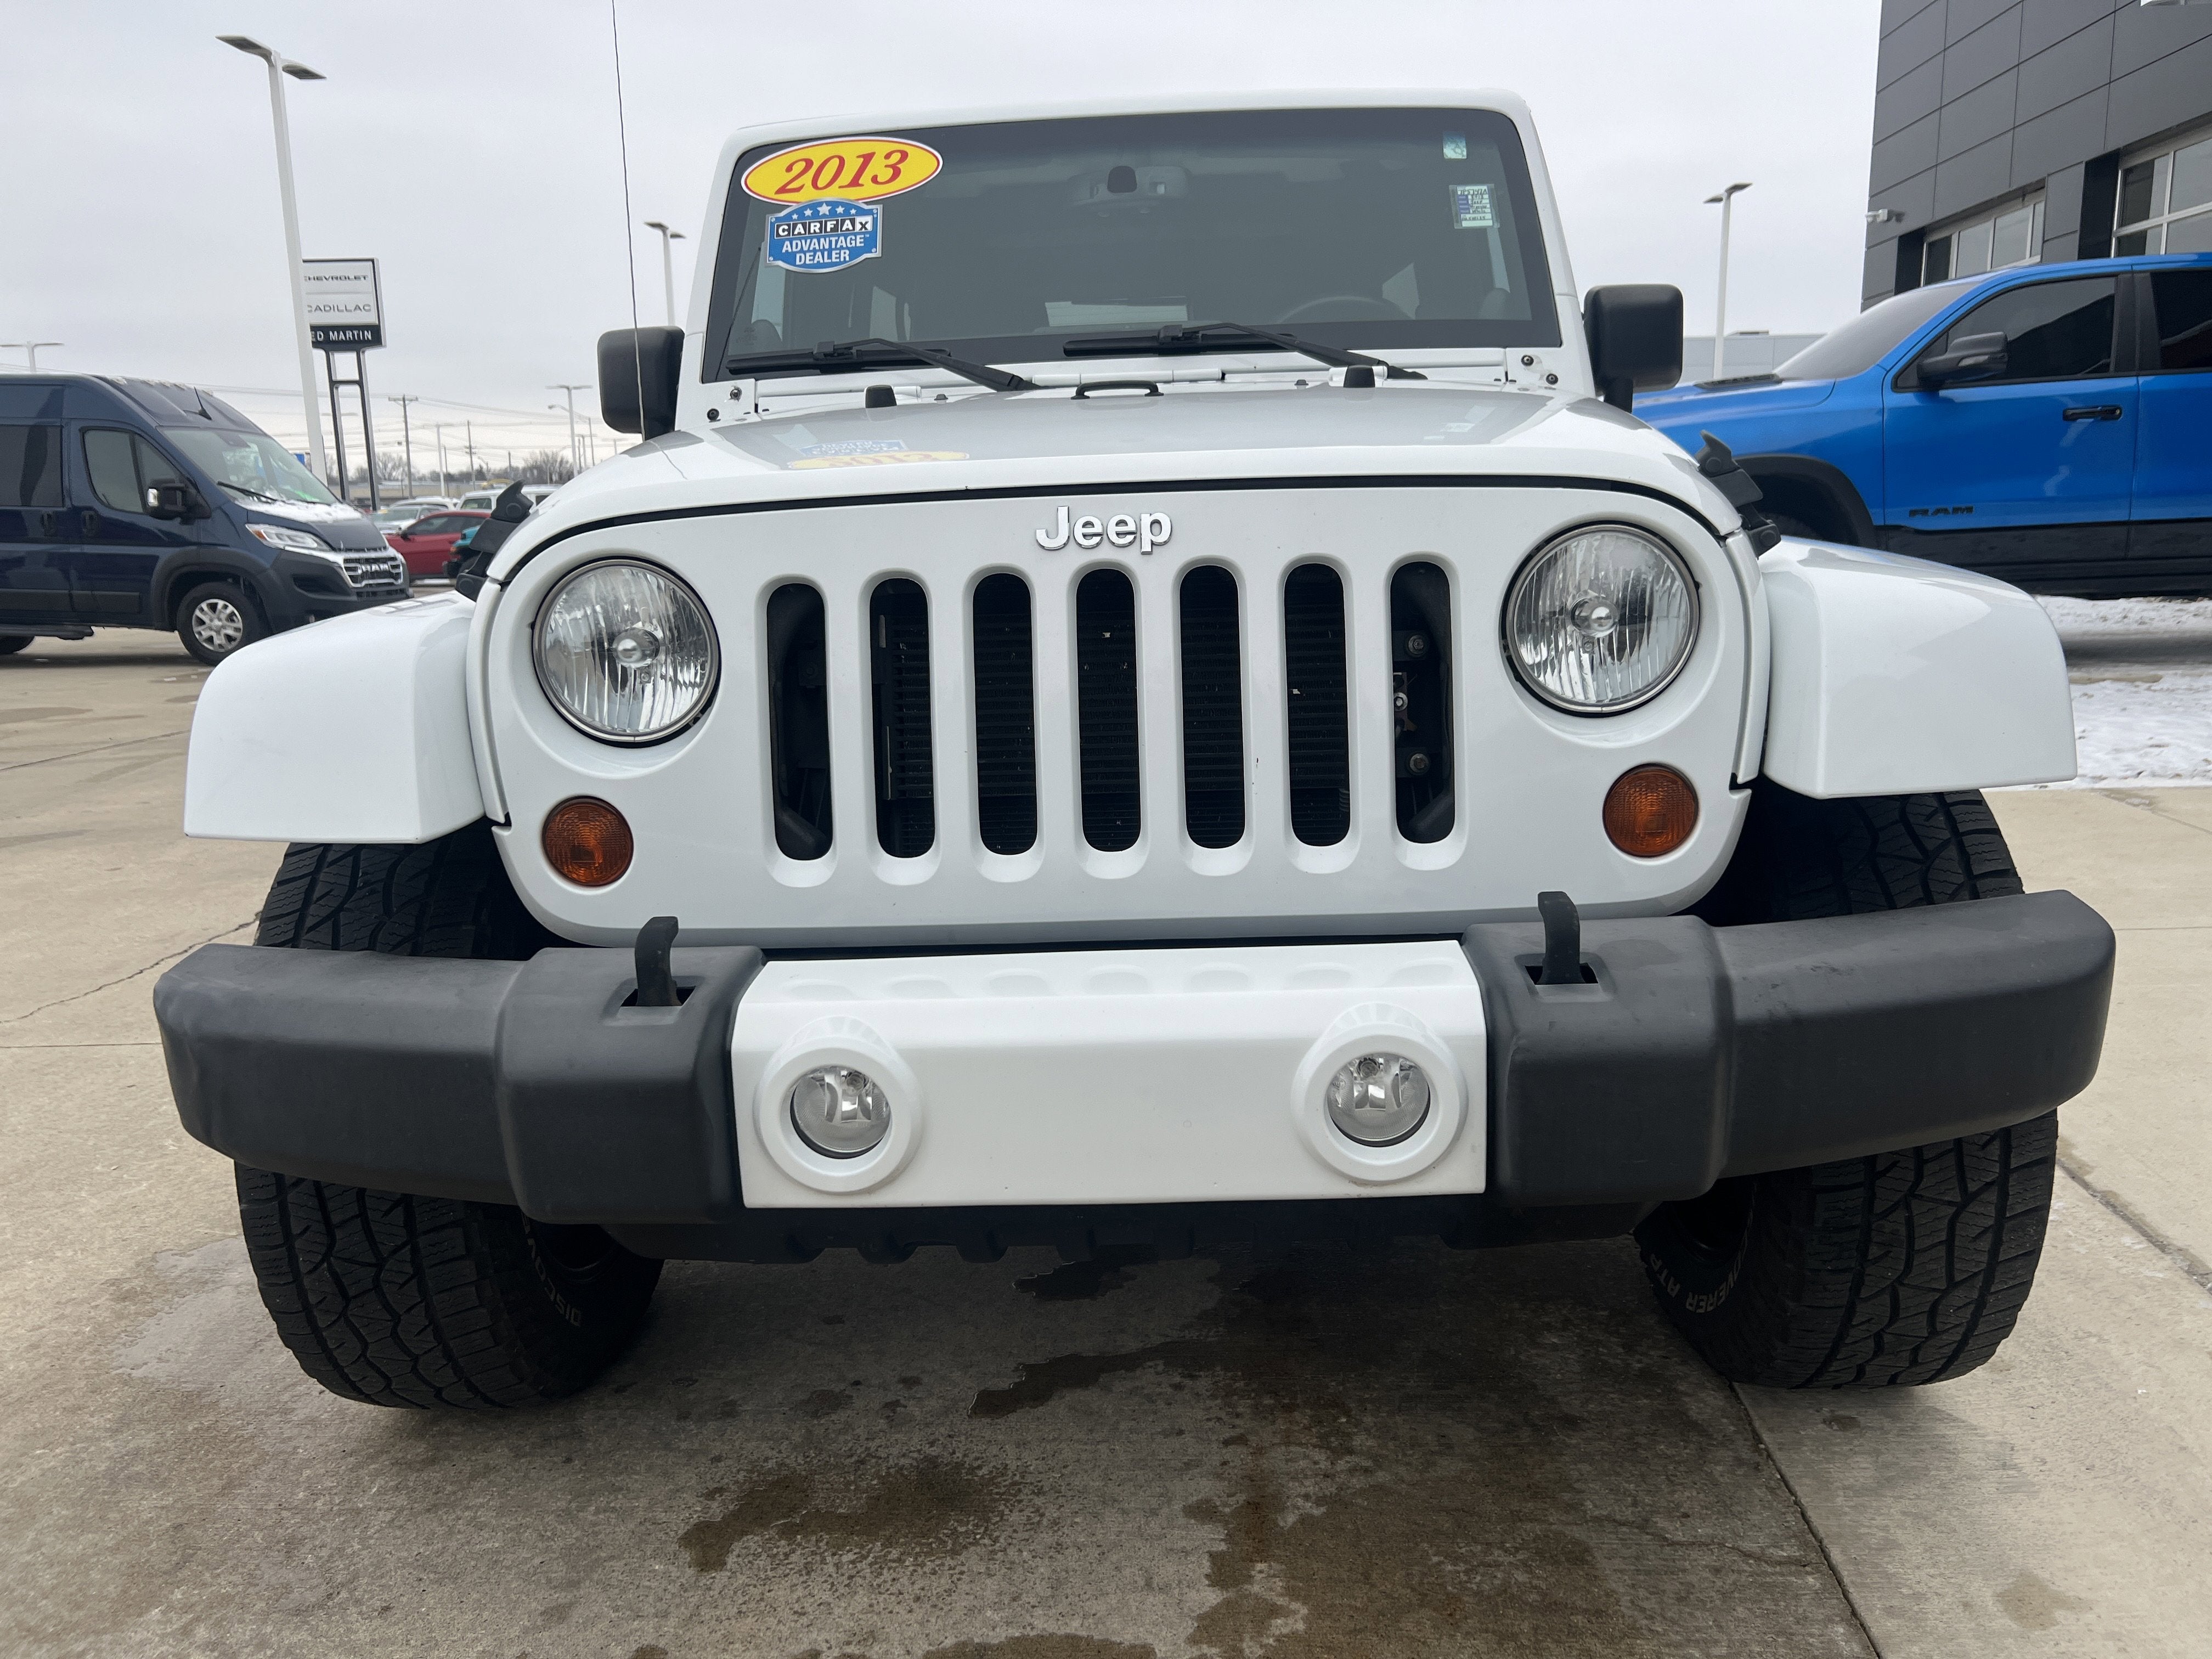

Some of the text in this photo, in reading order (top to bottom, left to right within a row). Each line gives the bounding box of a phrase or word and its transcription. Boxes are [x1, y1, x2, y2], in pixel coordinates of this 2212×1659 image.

[774, 149, 909, 195] 2013
[778, 219, 869, 236] CARFAX
[795, 250, 850, 266] DEALER
[329, 330, 372, 341] MARTIN
[1909, 505, 1973, 517] RAM
[1035, 505, 1172, 555] Jeep
